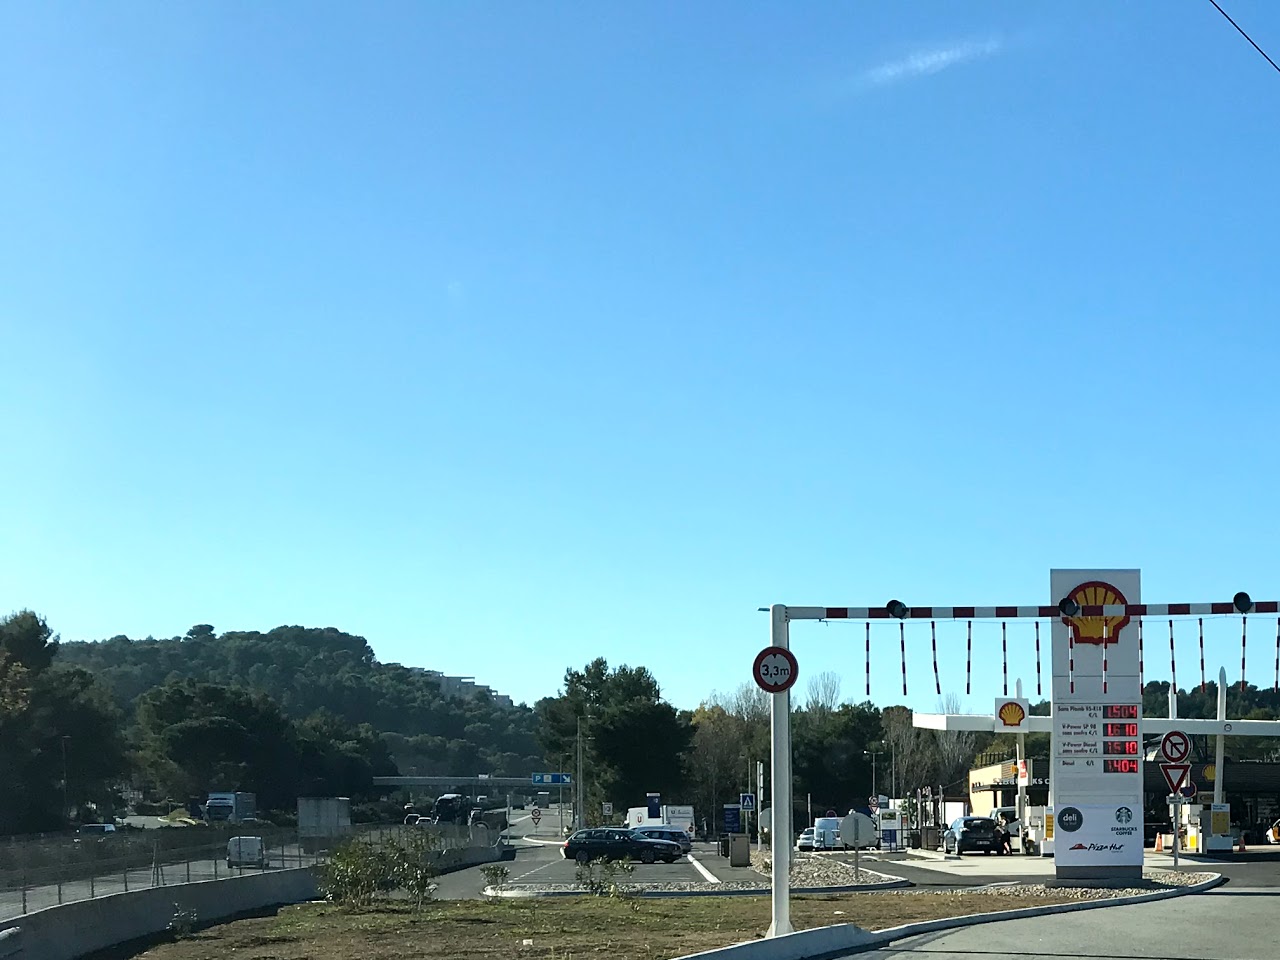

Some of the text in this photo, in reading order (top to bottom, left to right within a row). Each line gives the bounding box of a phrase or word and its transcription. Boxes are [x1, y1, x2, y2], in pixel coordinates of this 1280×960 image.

[762, 664, 789, 678] 3,3m
[1062, 813, 1077, 821] deli
[1087, 843, 1124, 851] Pizza Hut
